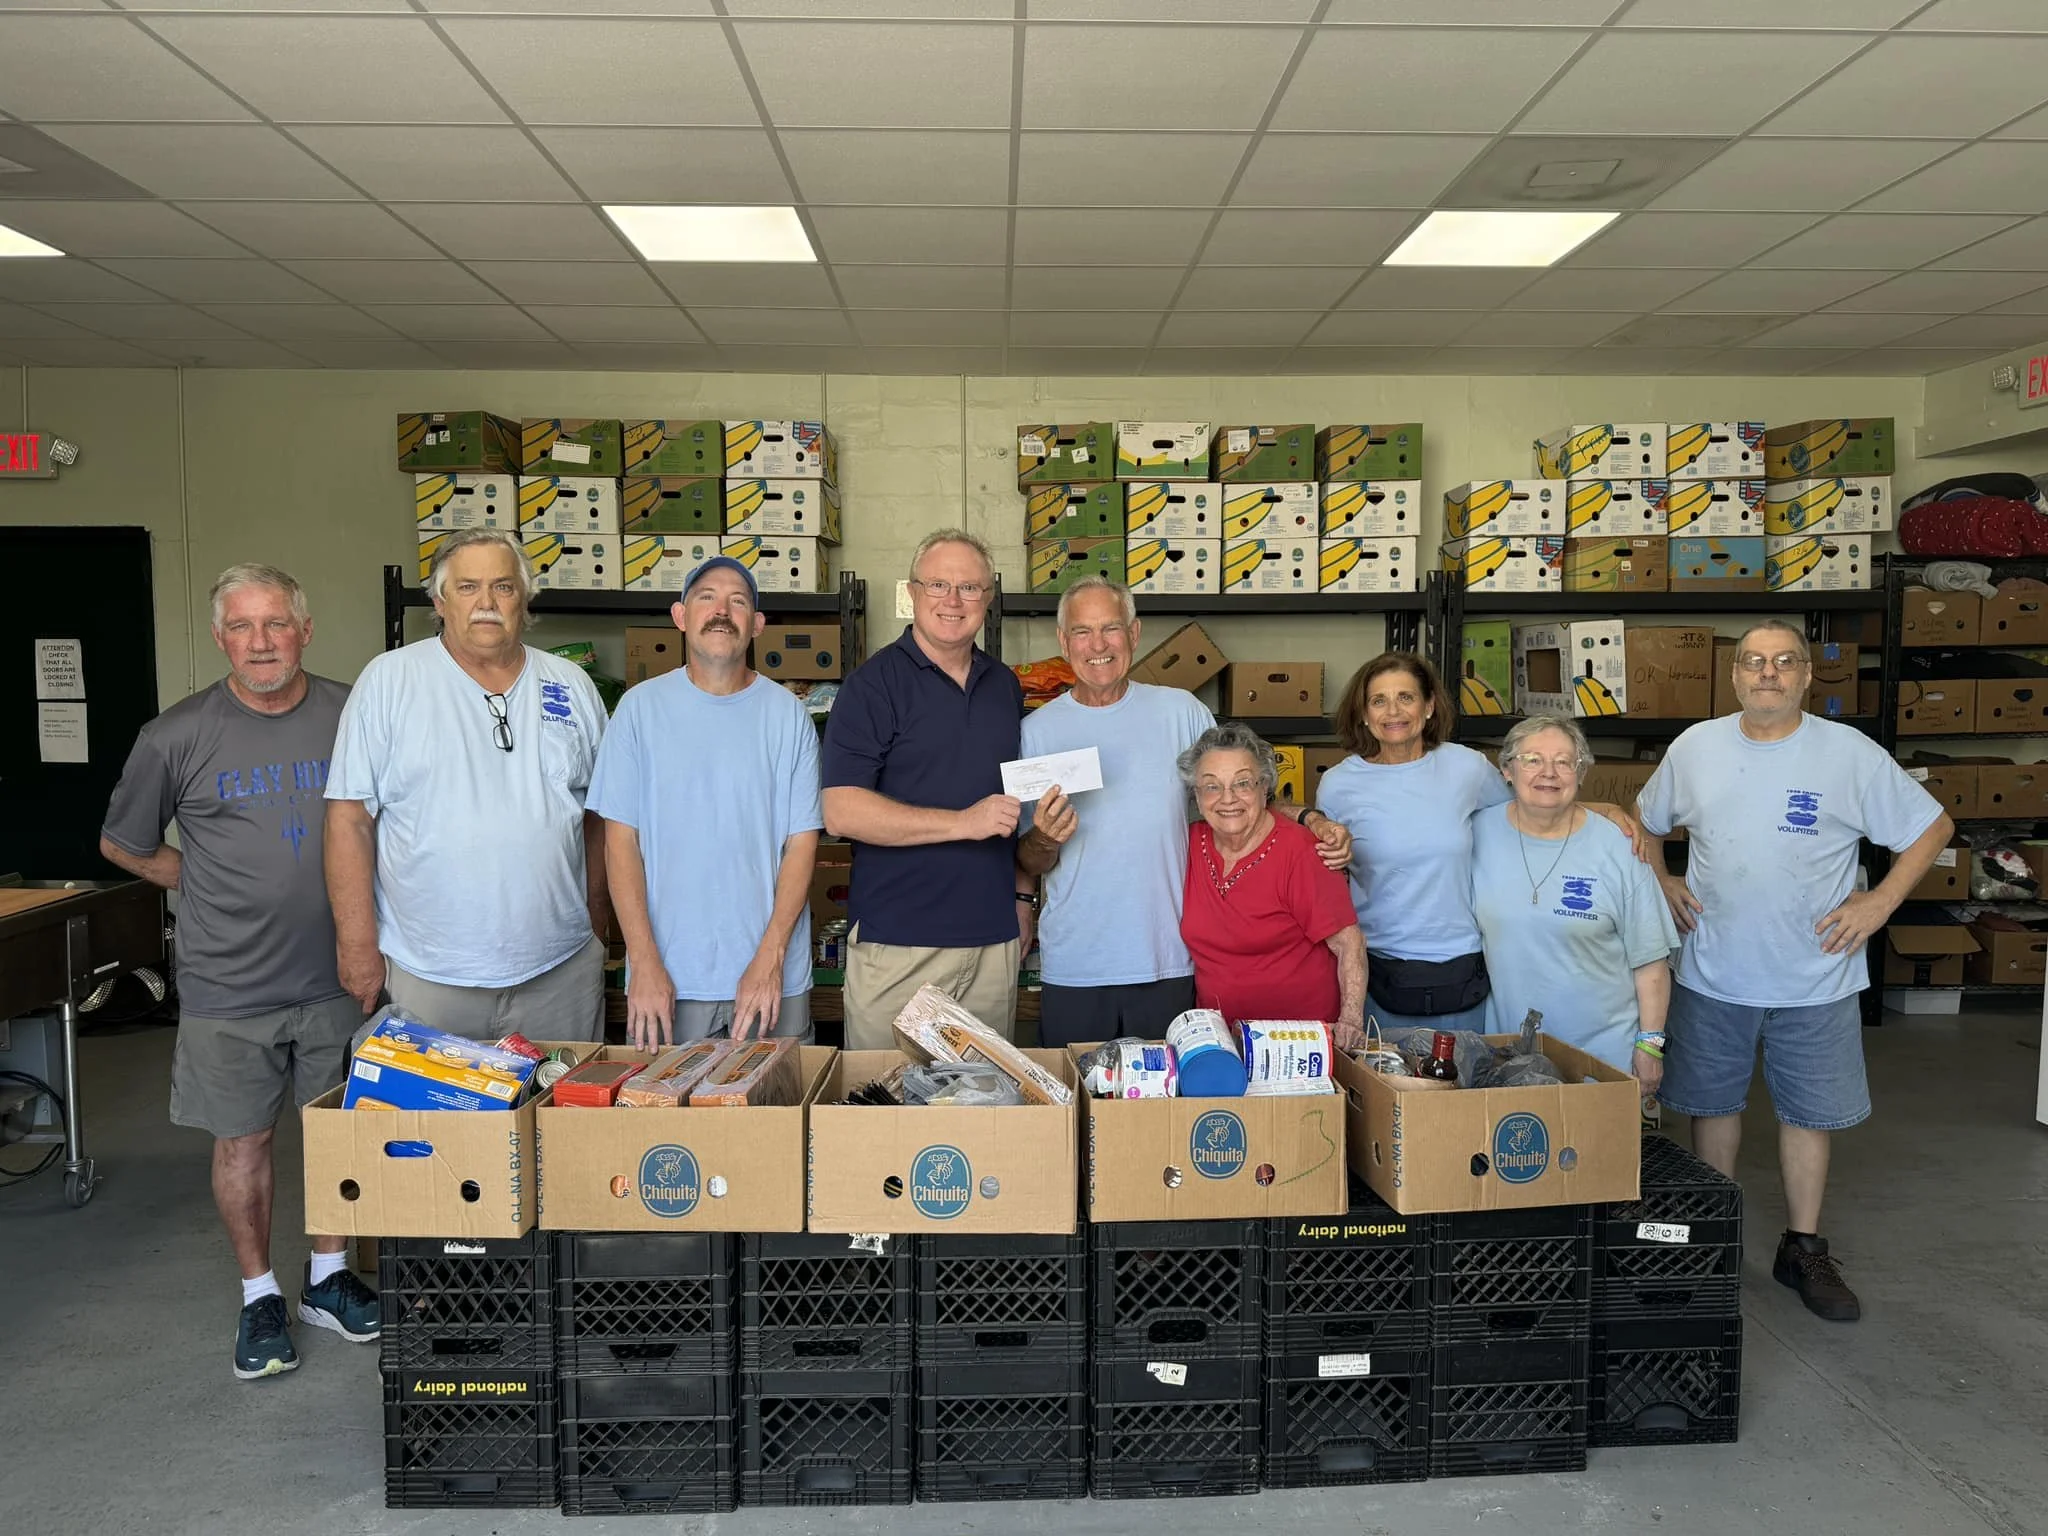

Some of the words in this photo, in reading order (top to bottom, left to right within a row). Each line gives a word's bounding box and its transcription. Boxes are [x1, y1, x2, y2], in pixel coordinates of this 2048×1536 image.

[541, 715, 578, 728] OLUNTEER
[217, 764, 283, 800] CLAY
[1777, 825, 1819, 836] VOLUNTEER
[1553, 908, 1599, 920] VOLUNTEER
[1297, 1057, 1307, 1075] A2+
[1311, 1054, 1320, 1077] Care
[509, 1130, 521, 1169] BX-07
[1192, 1147, 1244, 1168] Chiquita
[1495, 1152, 1547, 1173] Chiquita
[641, 1183, 698, 1205] Chiquita
[912, 1185, 970, 1206] Chiquita
[1298, 1223, 1339, 1239] dairy
[1344, 1223, 1407, 1239] national
[413, 1380, 456, 1396] dairy
[461, 1382, 527, 1396] national
